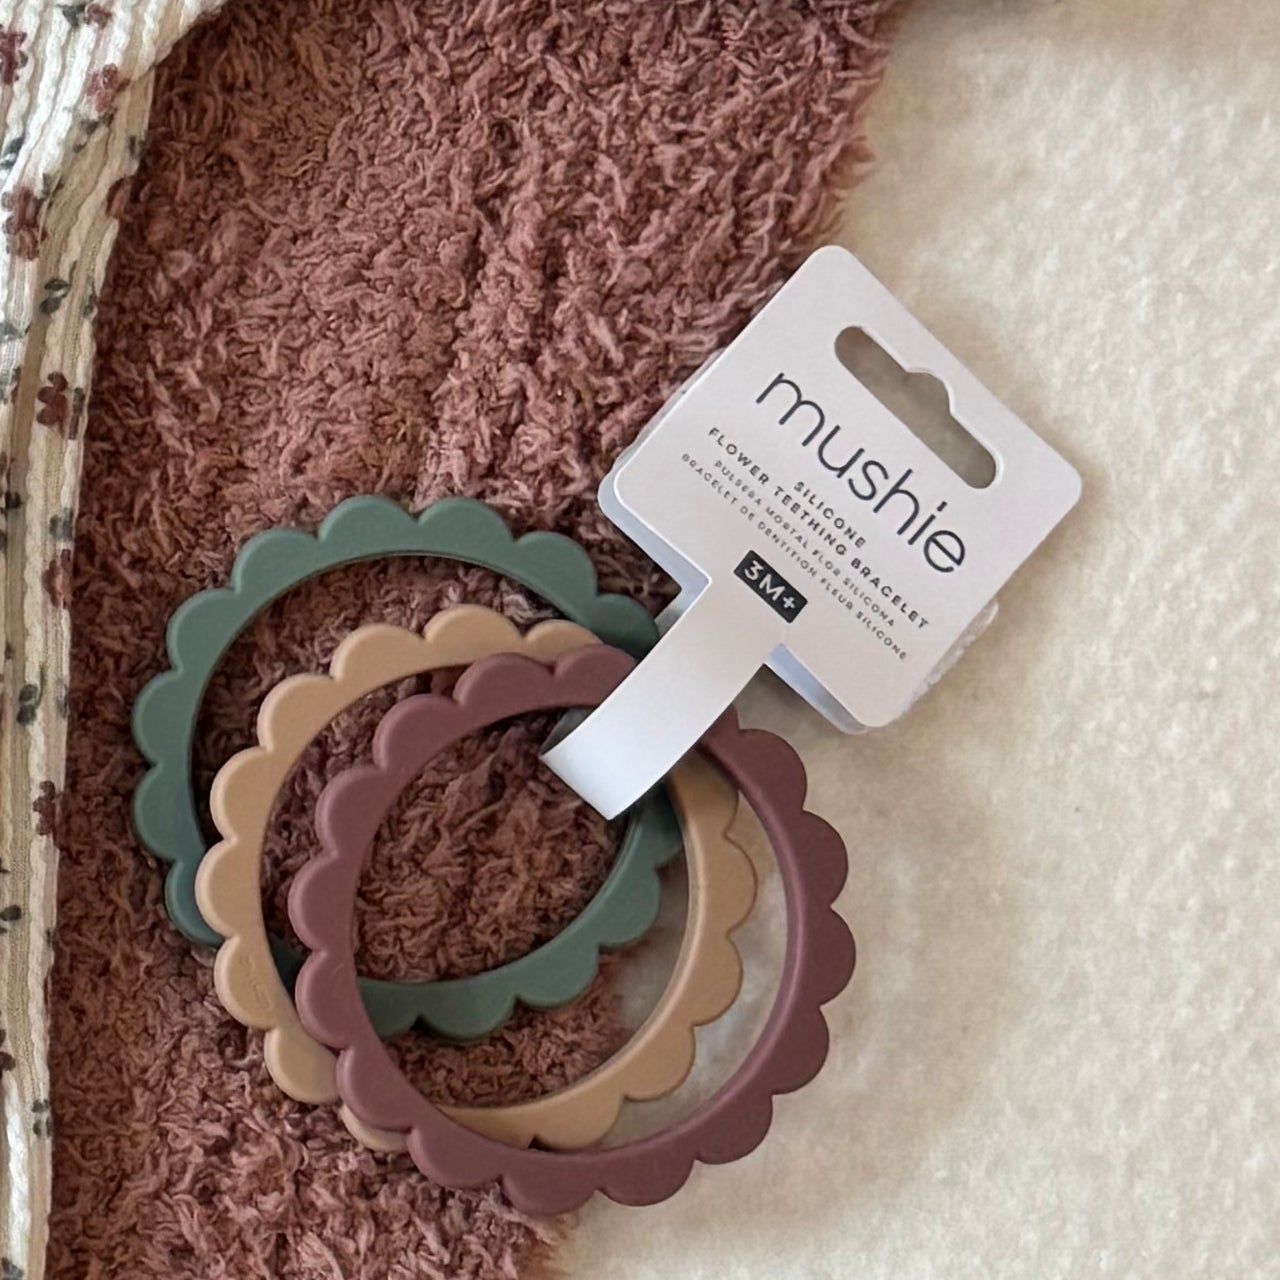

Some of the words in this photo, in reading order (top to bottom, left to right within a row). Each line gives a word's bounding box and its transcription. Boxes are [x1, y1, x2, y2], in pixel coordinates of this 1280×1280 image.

[682, 453, 738, 504] BRACELET
[740, 505, 755, 521] DE
[758, 521, 817, 576] DENTITION
[820, 578, 853, 610] FLEUR
[856, 611, 907, 660] SILICONE
[708, 427, 769, 485] FLOWER
[774, 486, 847, 555] TEETHING
[851, 558, 929, 629] BRACELET
[714, 460, 761, 505] PULSERA
[843, 578, 894, 626] SILICONA
[756, 372, 965, 572] mushie
[794, 481, 866, 548] SILICONE
[744, 560, 795, 609] 3M+
